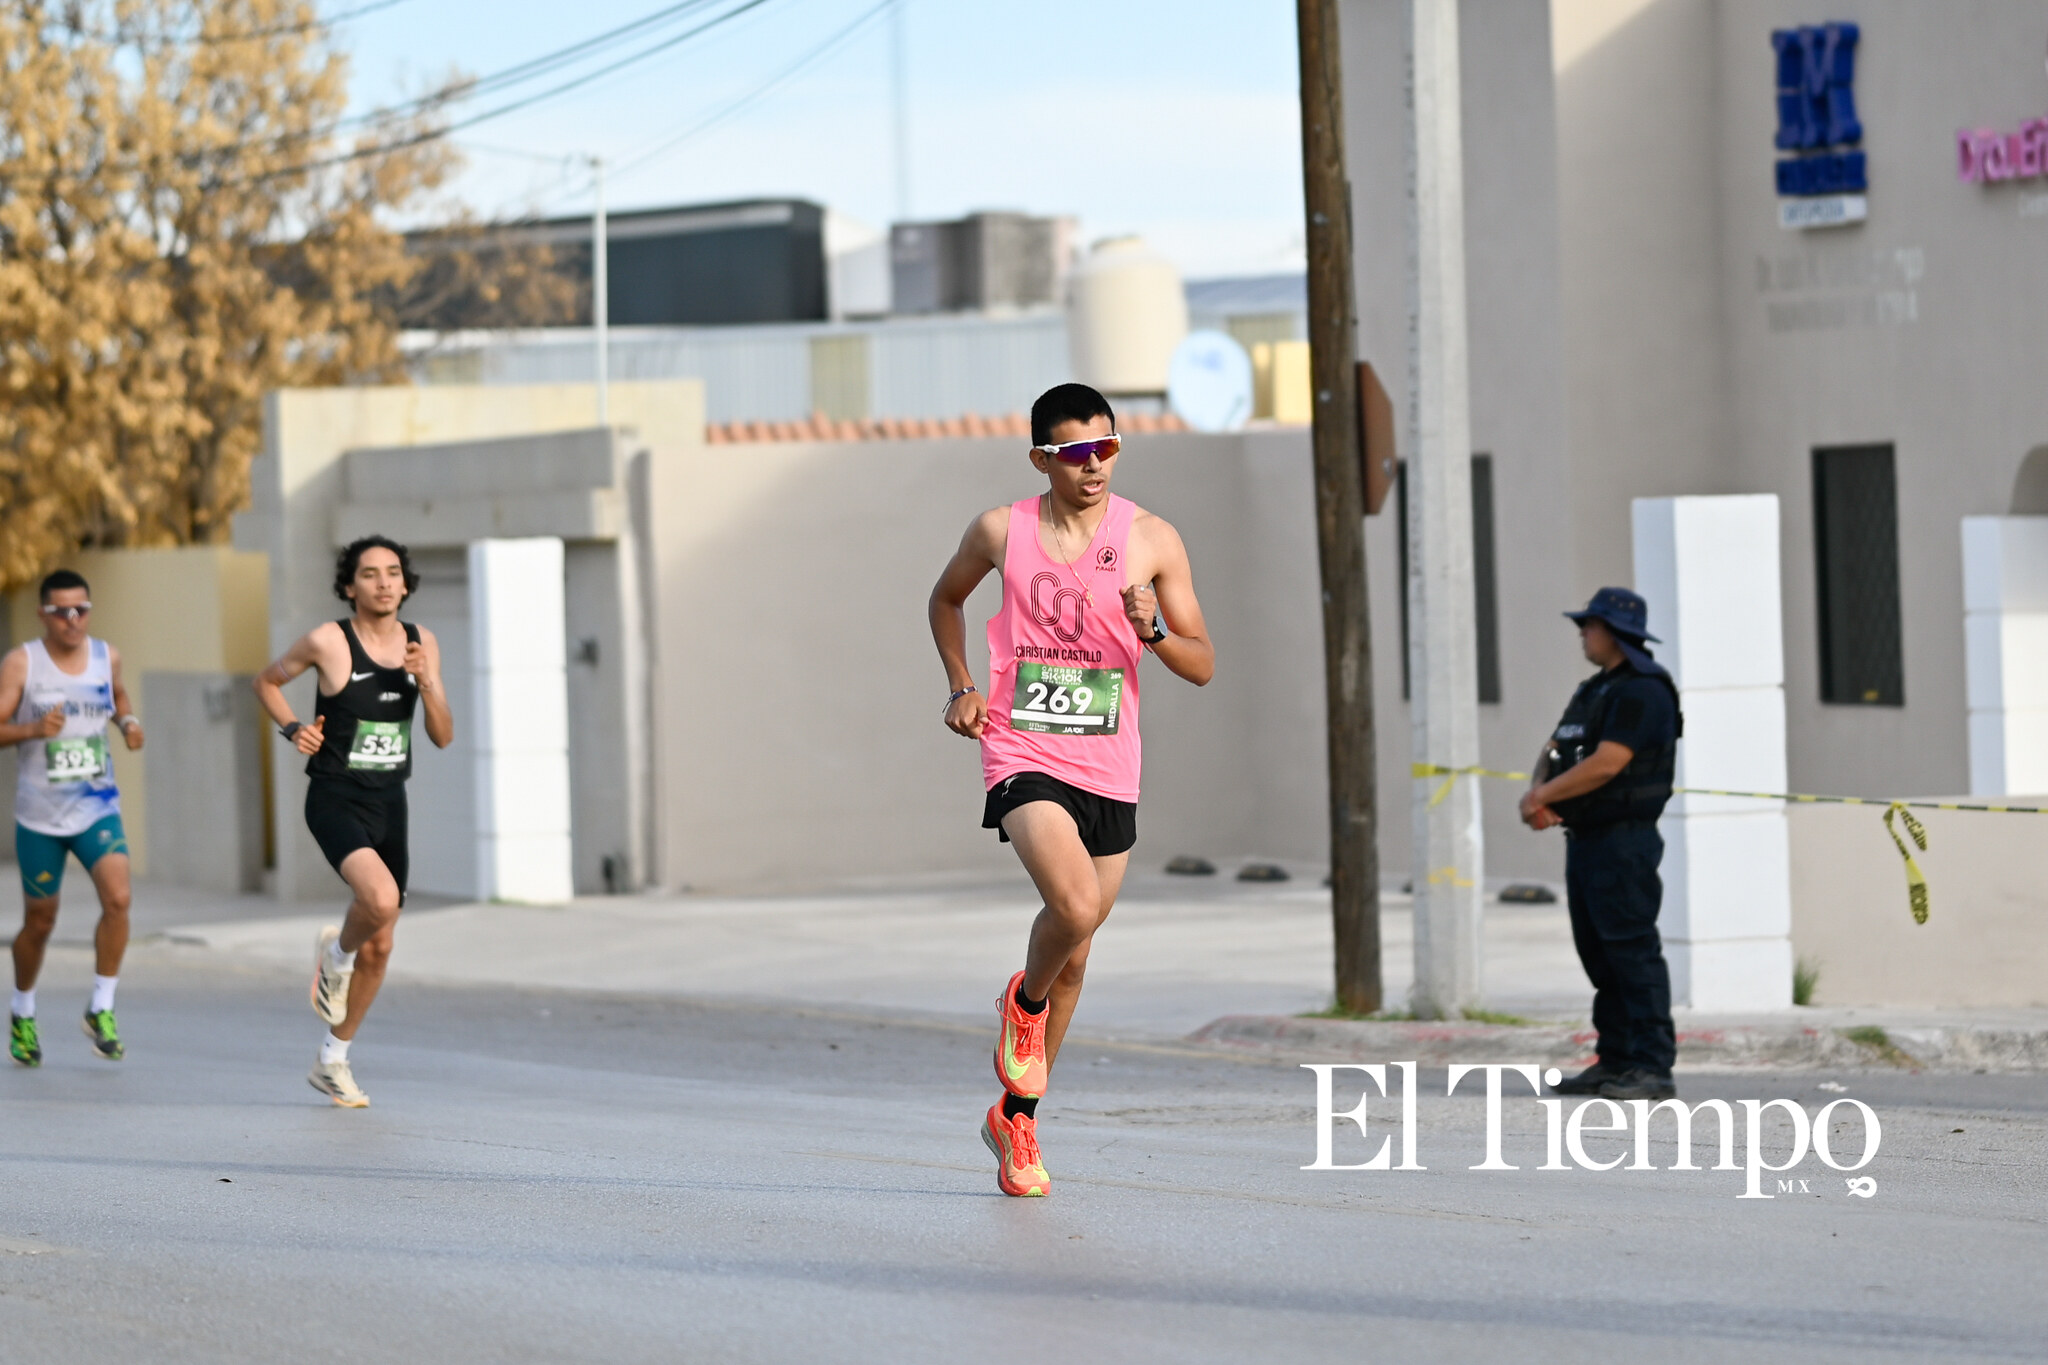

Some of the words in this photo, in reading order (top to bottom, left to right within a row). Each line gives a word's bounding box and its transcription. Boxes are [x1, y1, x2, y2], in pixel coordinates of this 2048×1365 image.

[1016, 646, 1059, 660] CHRISTIAN
[1061, 649, 1102, 662] CASTILLO
[1041, 666, 1082, 676] CARRERA
[1025, 682, 1093, 714] 269
[1107, 683, 1120, 728] MEDALLA
[361, 734, 403, 755] 534
[55, 747, 95, 771] 595
